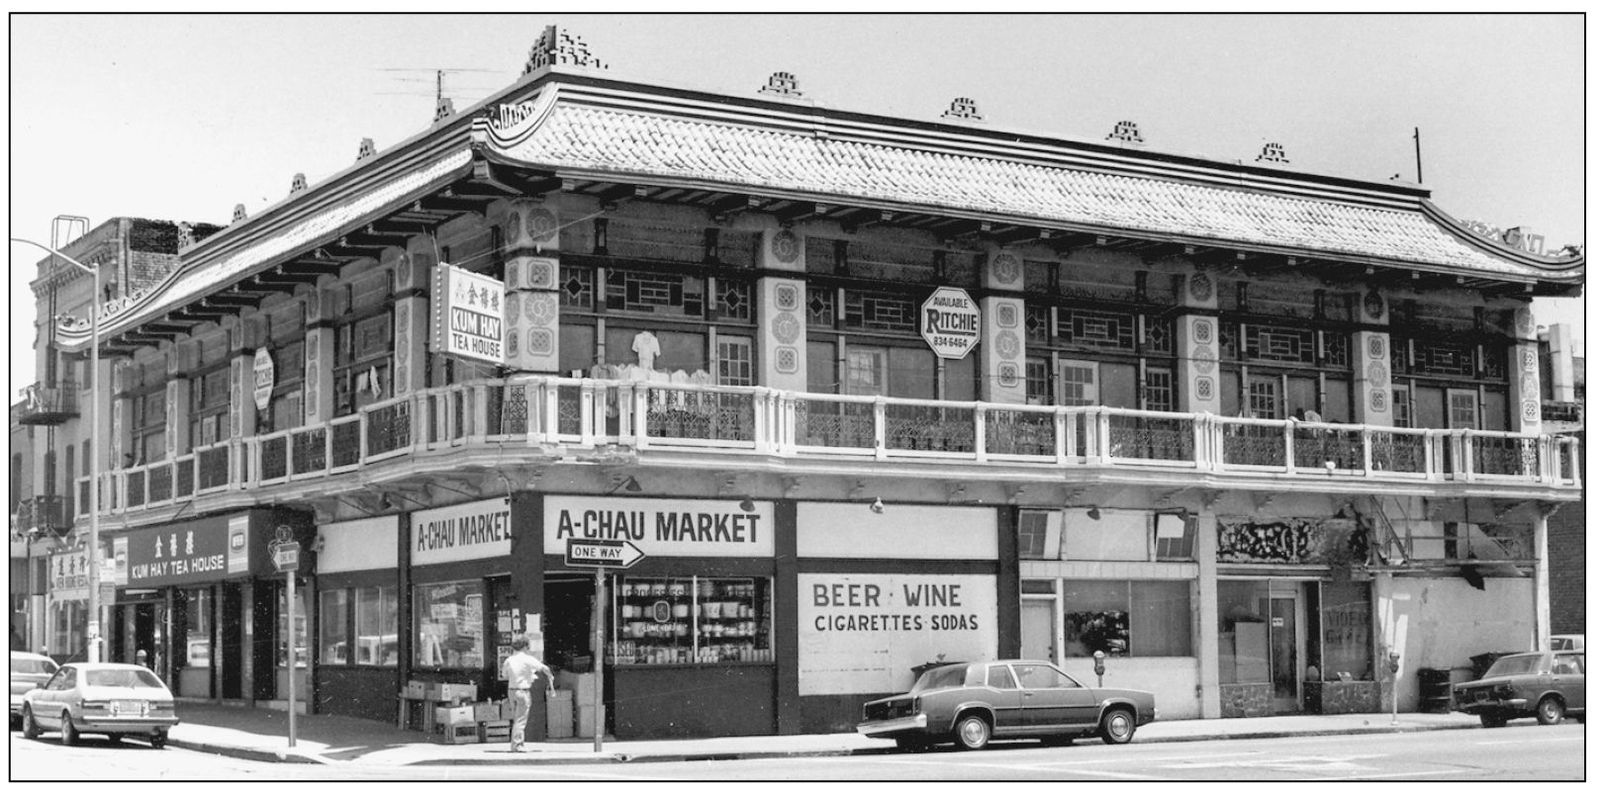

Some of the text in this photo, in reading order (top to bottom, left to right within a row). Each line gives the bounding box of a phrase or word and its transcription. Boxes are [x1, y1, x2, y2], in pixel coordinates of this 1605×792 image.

[933, 297, 969, 309] AVAILABLE
[452, 308, 500, 340] KUM HAY
[926, 308, 977, 335] RITCHIE
[452, 333, 501, 358] TEA HOUSE
[417, 511, 510, 552] A-CHAU MARKET
[557, 509, 761, 543] A-CHAU MARKET
[574, 546, 623, 559] ONE WAY
[132, 554, 224, 579] KUM HAY TEA HOUSE
[813, 583, 962, 608] BEER WINE
